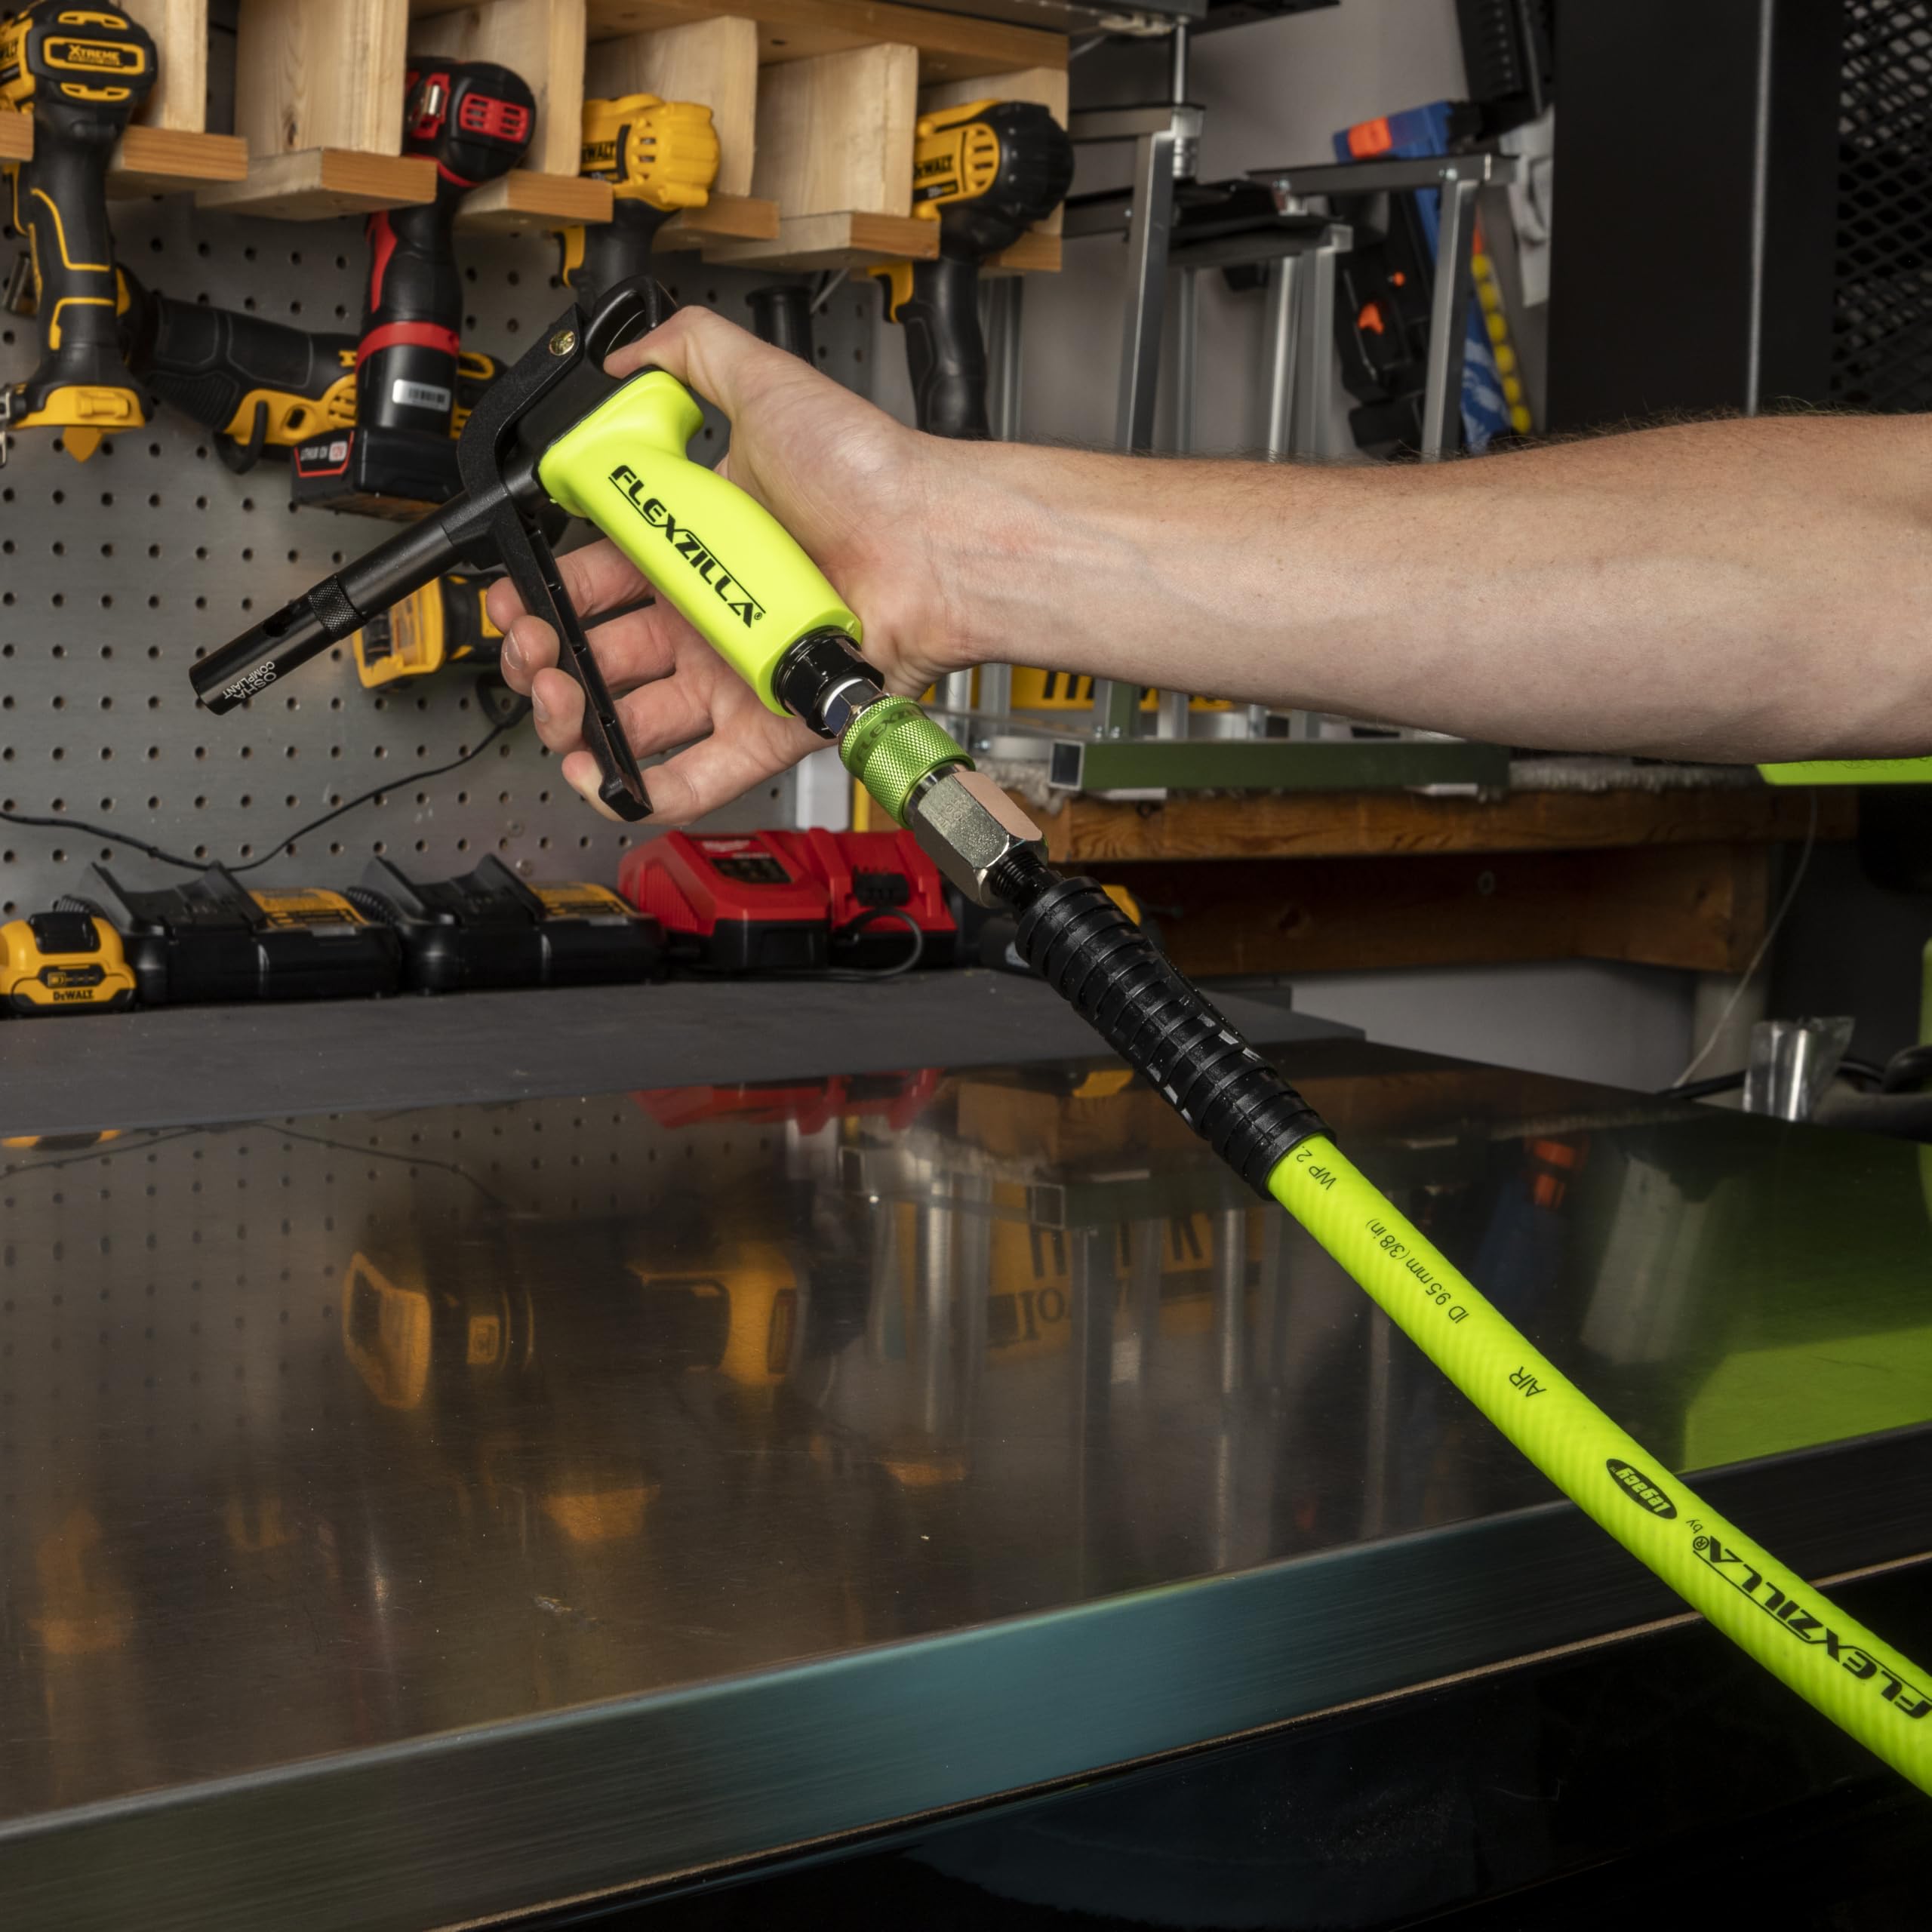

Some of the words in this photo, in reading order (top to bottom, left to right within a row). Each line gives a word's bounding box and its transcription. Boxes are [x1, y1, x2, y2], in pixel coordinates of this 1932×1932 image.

[69, 45, 121, 60] XTREME
[223, 661, 275, 700] COMPLIANT
[233, 672, 277, 699] OSHA
[1309, 1165, 1337, 1190] WP
[1364, 1218, 1387, 1239] in)
[1380, 1235, 1411, 1260] (3/8
[1406, 1258, 1434, 1284] mm
[1426, 1283, 1451, 1306] 9.5
[1448, 1306, 1469, 1324] ID
[1509, 1366, 1547, 1398] AIR
[1614, 1467, 1672, 1513] Legacy
[1685, 1518, 1703, 1534] by
